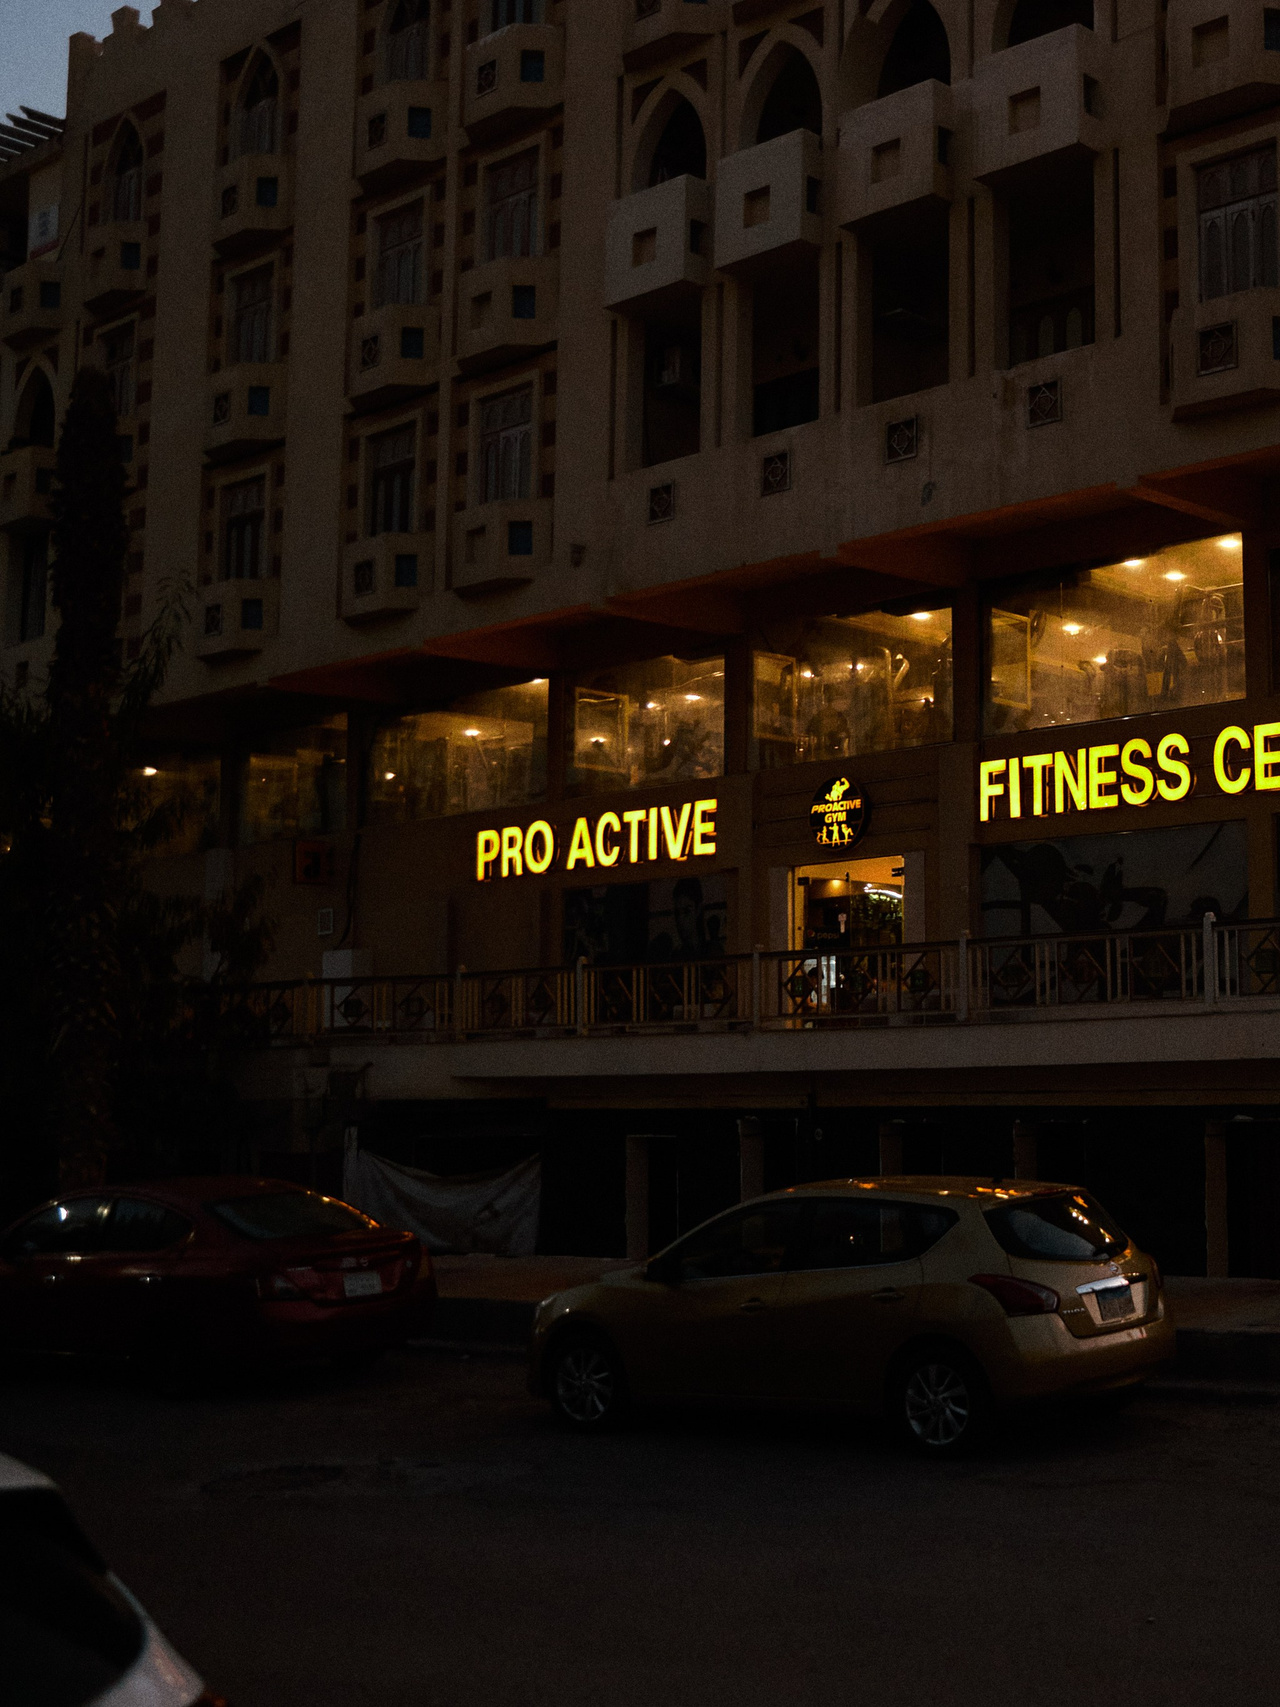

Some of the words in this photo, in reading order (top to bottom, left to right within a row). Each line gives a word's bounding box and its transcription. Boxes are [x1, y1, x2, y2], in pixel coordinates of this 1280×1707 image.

[979, 732, 1193, 823] FITNESS
[811, 799, 862, 815] PROACTIVE
[824, 811, 847, 824] GYM
[476, 820, 555, 882] PRO
[566, 798, 718, 871] ACTIVE
